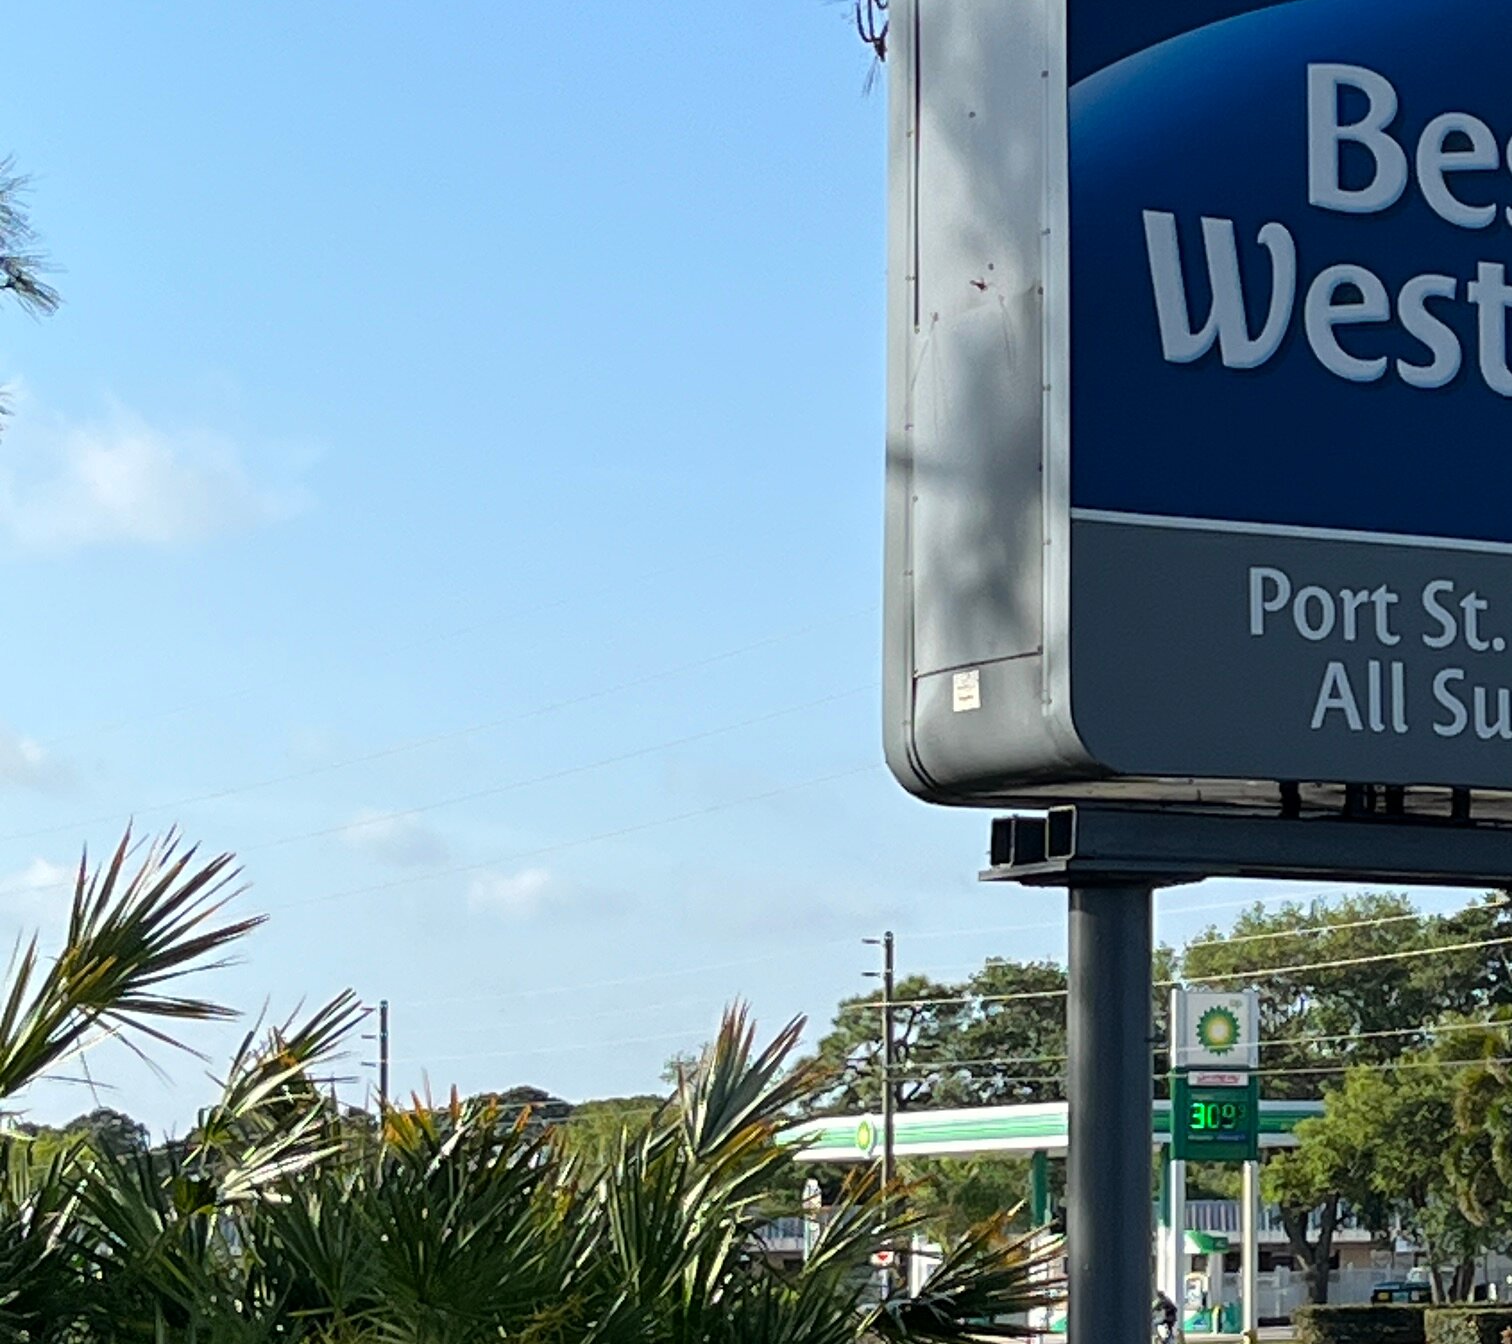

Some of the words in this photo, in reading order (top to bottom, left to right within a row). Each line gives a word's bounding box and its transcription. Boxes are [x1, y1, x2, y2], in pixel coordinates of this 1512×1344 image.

[1249, 566, 1401, 646] Port
[1422, 580, 1506, 652] St.
[1310, 659, 1409, 734] All
